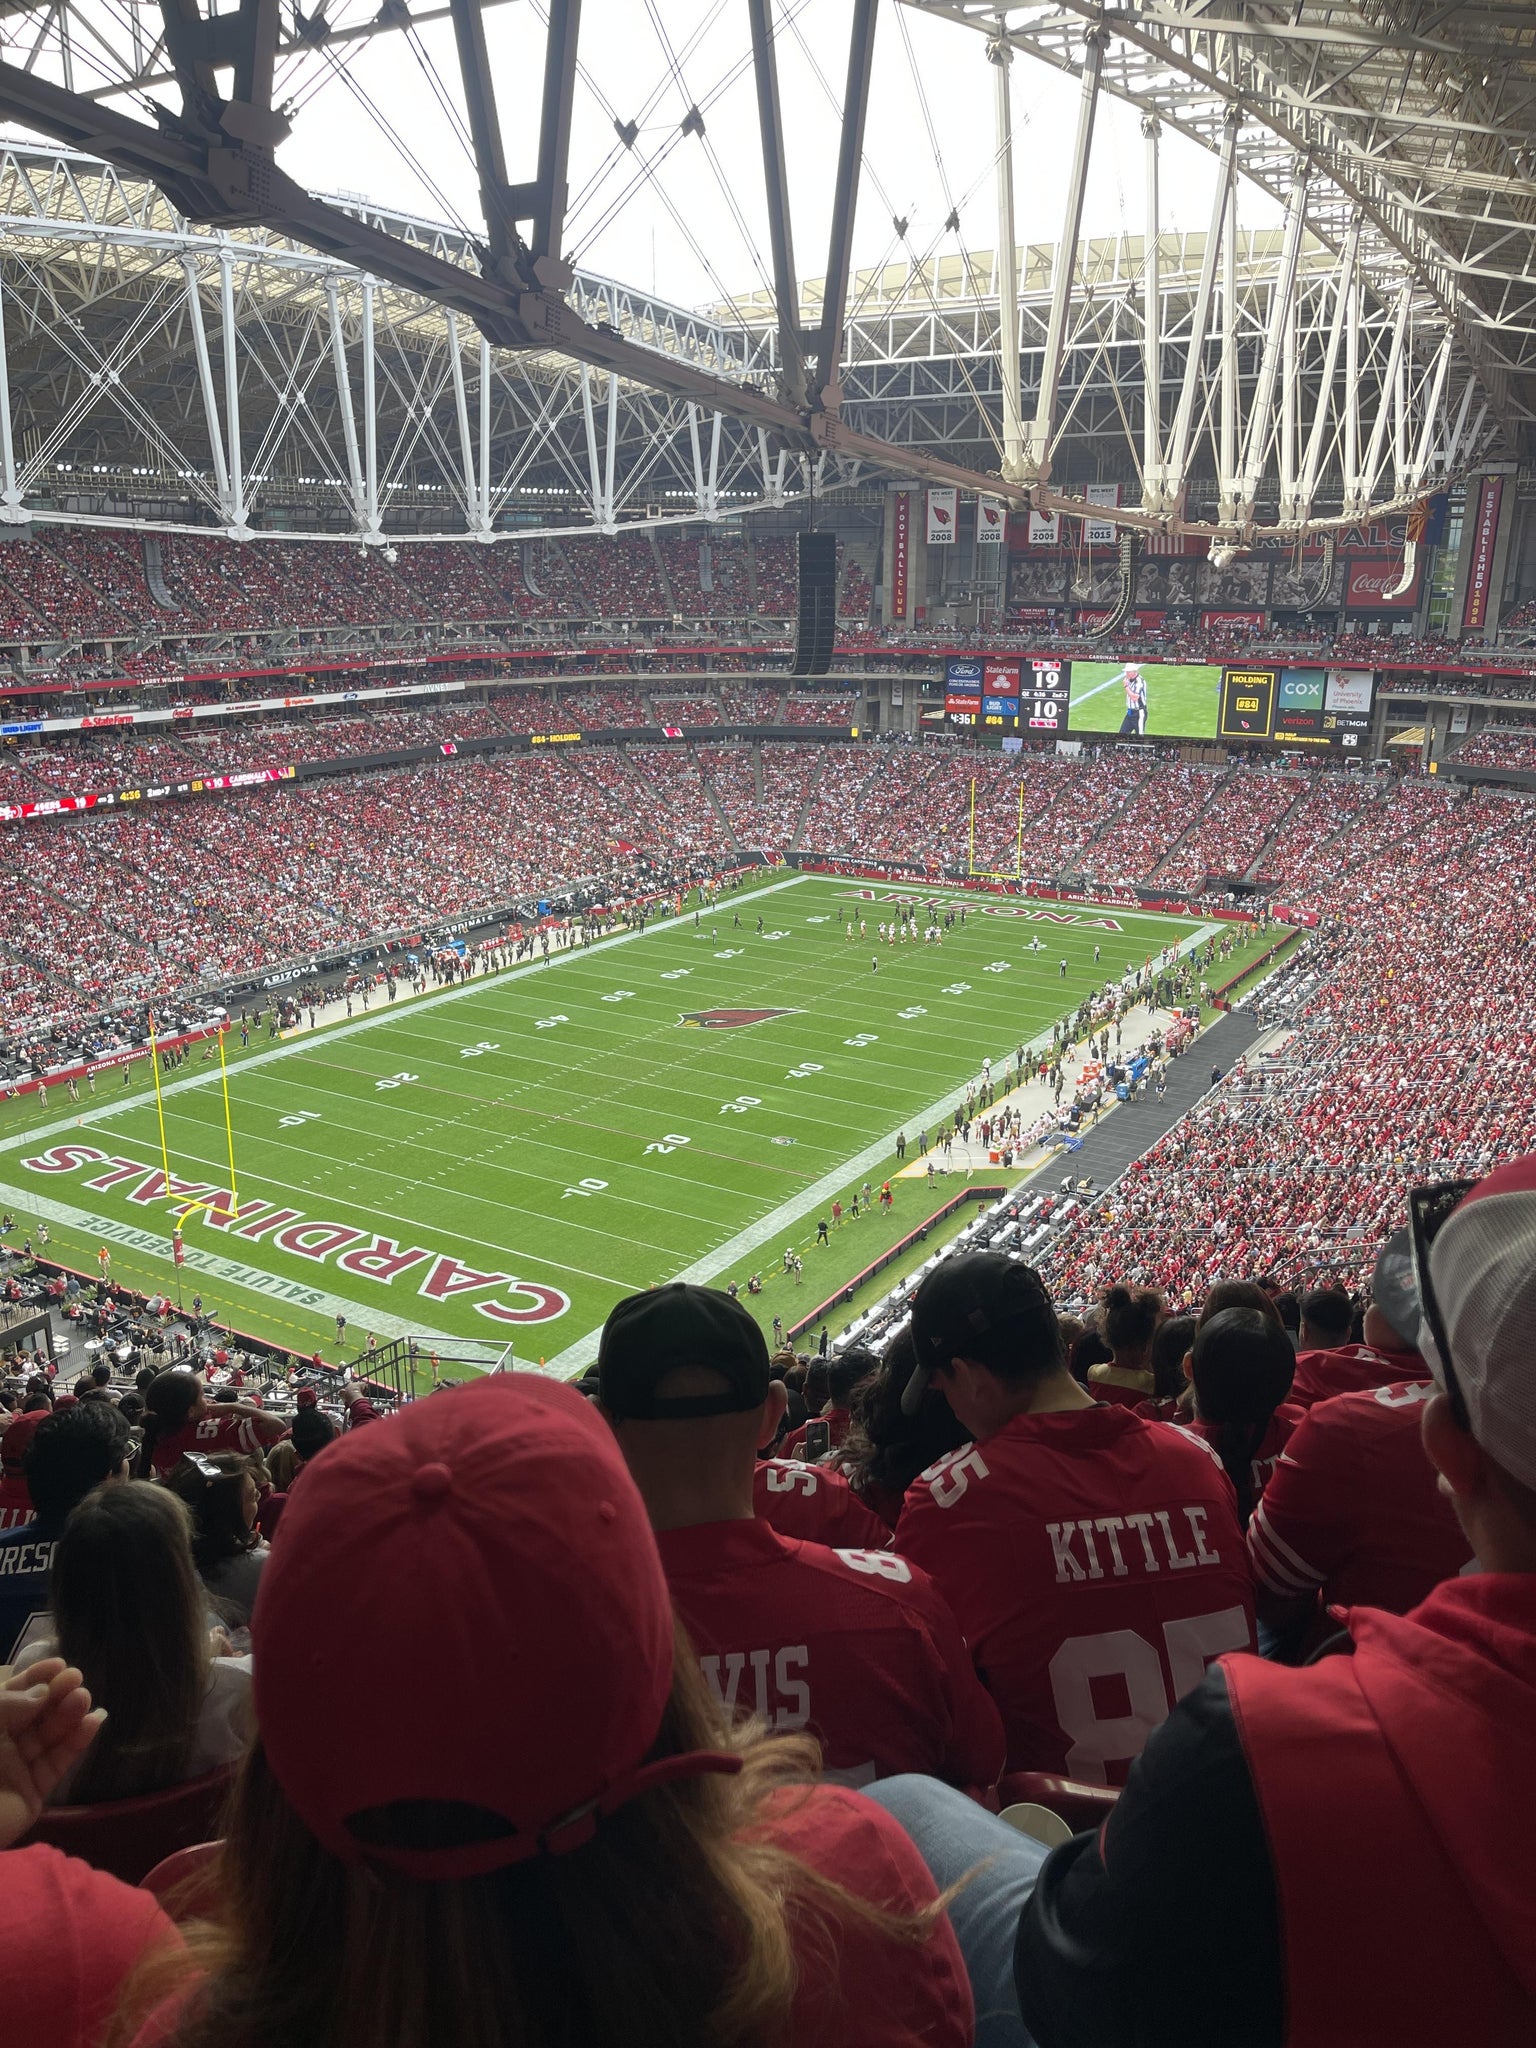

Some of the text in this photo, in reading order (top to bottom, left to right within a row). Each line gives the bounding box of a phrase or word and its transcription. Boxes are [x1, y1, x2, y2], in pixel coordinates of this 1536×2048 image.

[930, 533, 952, 541] 2008
[980, 533, 1001, 541] 2008
[1088, 531, 1111, 539] 2015
[1351, 573, 1404, 594] Coca-Co
[954, 665, 975, 675] Ford
[141, 677, 161, 685] LARRY
[1036, 671, 1060, 689] 19
[1232, 676, 1268, 684] HOLDING
[1284, 682, 1320, 696] COX
[1333, 691, 1363, 699] University
[1034, 700, 1058, 718] 10
[1238, 700, 1256, 709] #84
[950, 714, 971, 725] 4:36
[1282, 717, 1314, 726] verizon
[34, 800, 61, 812] 49ERS
[75, 797, 87, 808] 19
[120, 790, 141, 800] 4:36
[213, 778, 224, 789] 10
[229, 770, 267, 784] CARDINALS
[1102, 898, 1142, 908] CARDINAS
[831, 889, 1124, 932] ARIZONA
[762, 930, 791, 940] 20
[713, 948, 745, 958] 30
[660, 968, 694, 979] 40
[982, 961, 1012, 973] 20
[941, 982, 972, 995] 30
[600, 990, 636, 1002] 50
[897, 1005, 928, 1019] 40
[534, 1014, 570, 1029] 40
[843, 1033, 880, 1047] 50
[460, 1041, 500, 1057] 30
[86, 1060, 116, 1072] ARIZONA
[787, 1062, 824, 1078] 40
[375, 1072, 420, 1090] 20
[720, 1096, 762, 1114] 30
[278, 1110, 322, 1128] 10
[645, 1134, 692, 1154] 20
[562, 1178, 609, 1199] 10
[20, 1144, 571, 1325] CARDINALS
[76, 1216, 326, 1306] SALUTE TO SERVICE
[1046, 1506, 1221, 1583] KITTLE
[0, 1541, 59, 1575] RES
[832, 1548, 912, 1584] 8
[700, 1645, 811, 1731] VIS
